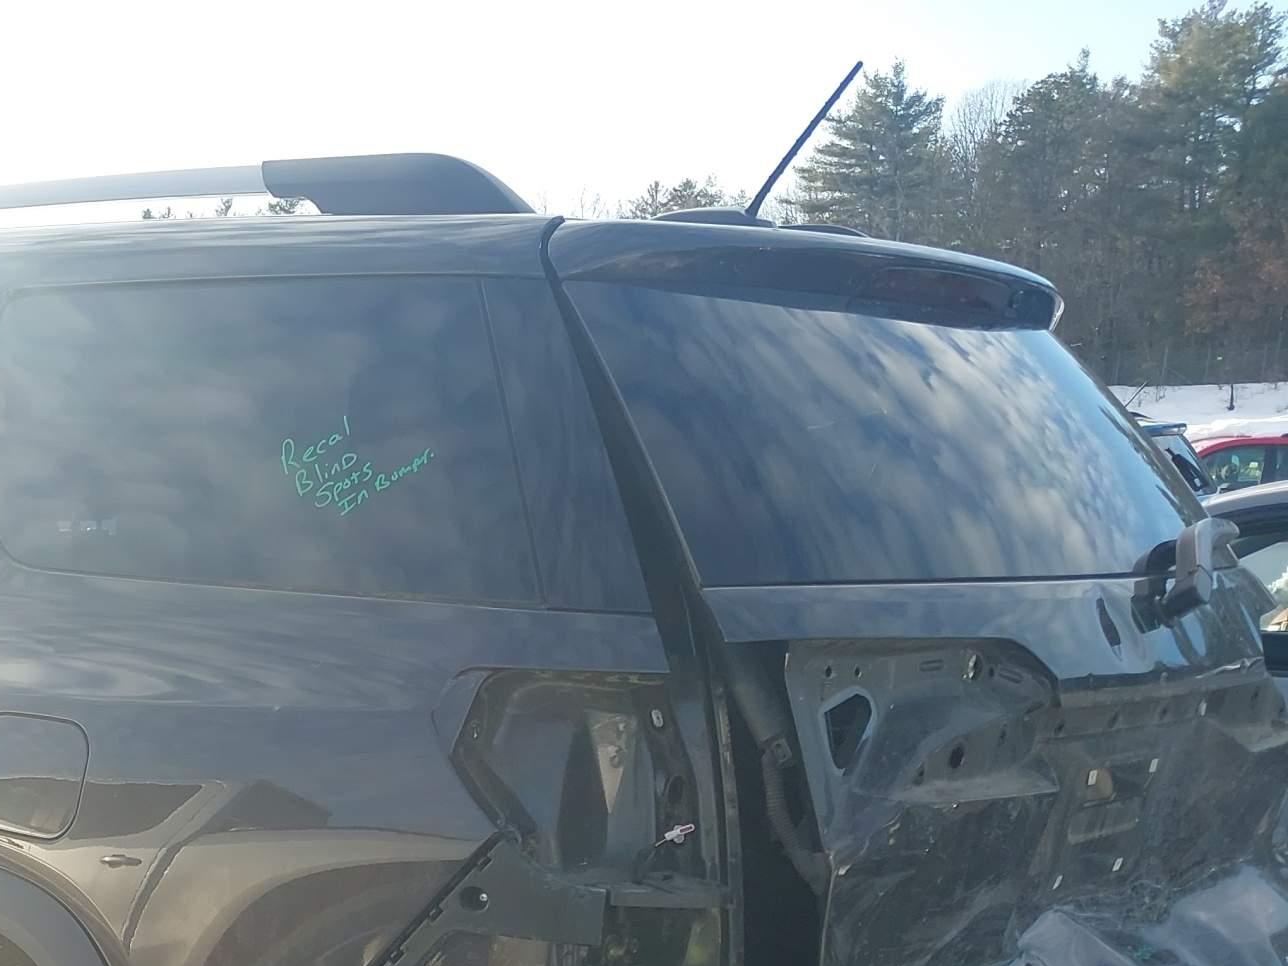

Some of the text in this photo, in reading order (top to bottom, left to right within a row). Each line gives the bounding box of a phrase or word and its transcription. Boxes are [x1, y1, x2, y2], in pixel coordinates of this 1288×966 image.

[280, 415, 350, 474] Recal
[314, 462, 373, 508] Spots
[337, 489, 369, 517] In
